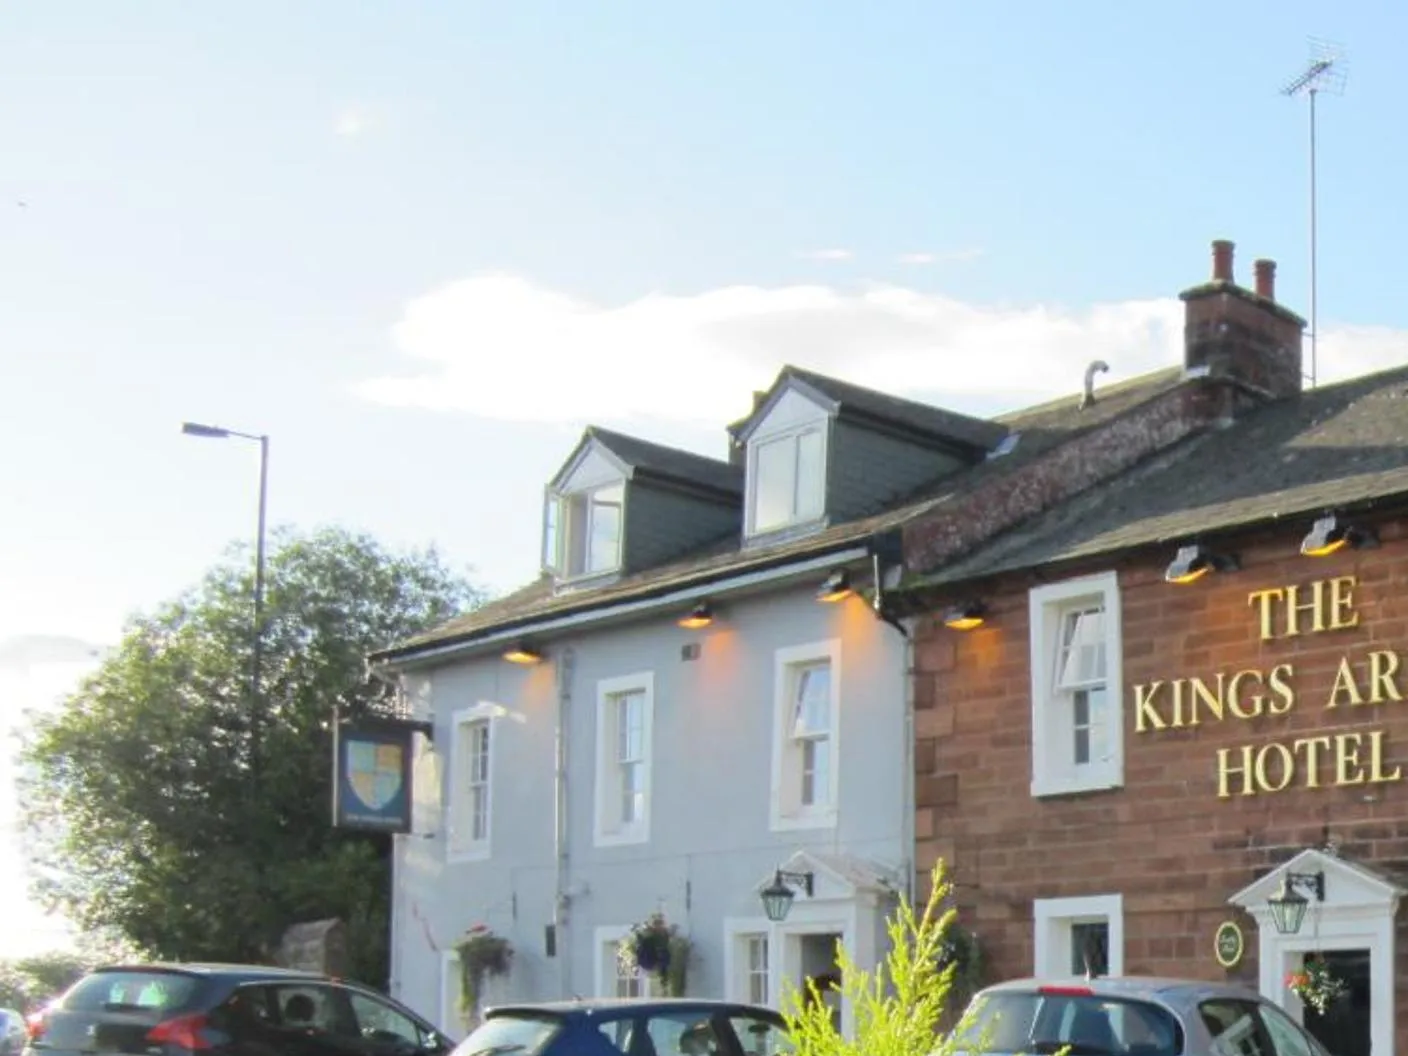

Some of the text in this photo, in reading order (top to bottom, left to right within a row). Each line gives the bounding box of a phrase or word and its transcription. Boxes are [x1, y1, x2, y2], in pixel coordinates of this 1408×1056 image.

[1249, 576, 1359, 640] THE
[1133, 664, 1294, 733] KINGS
[1217, 732, 1401, 798] HOTEL
